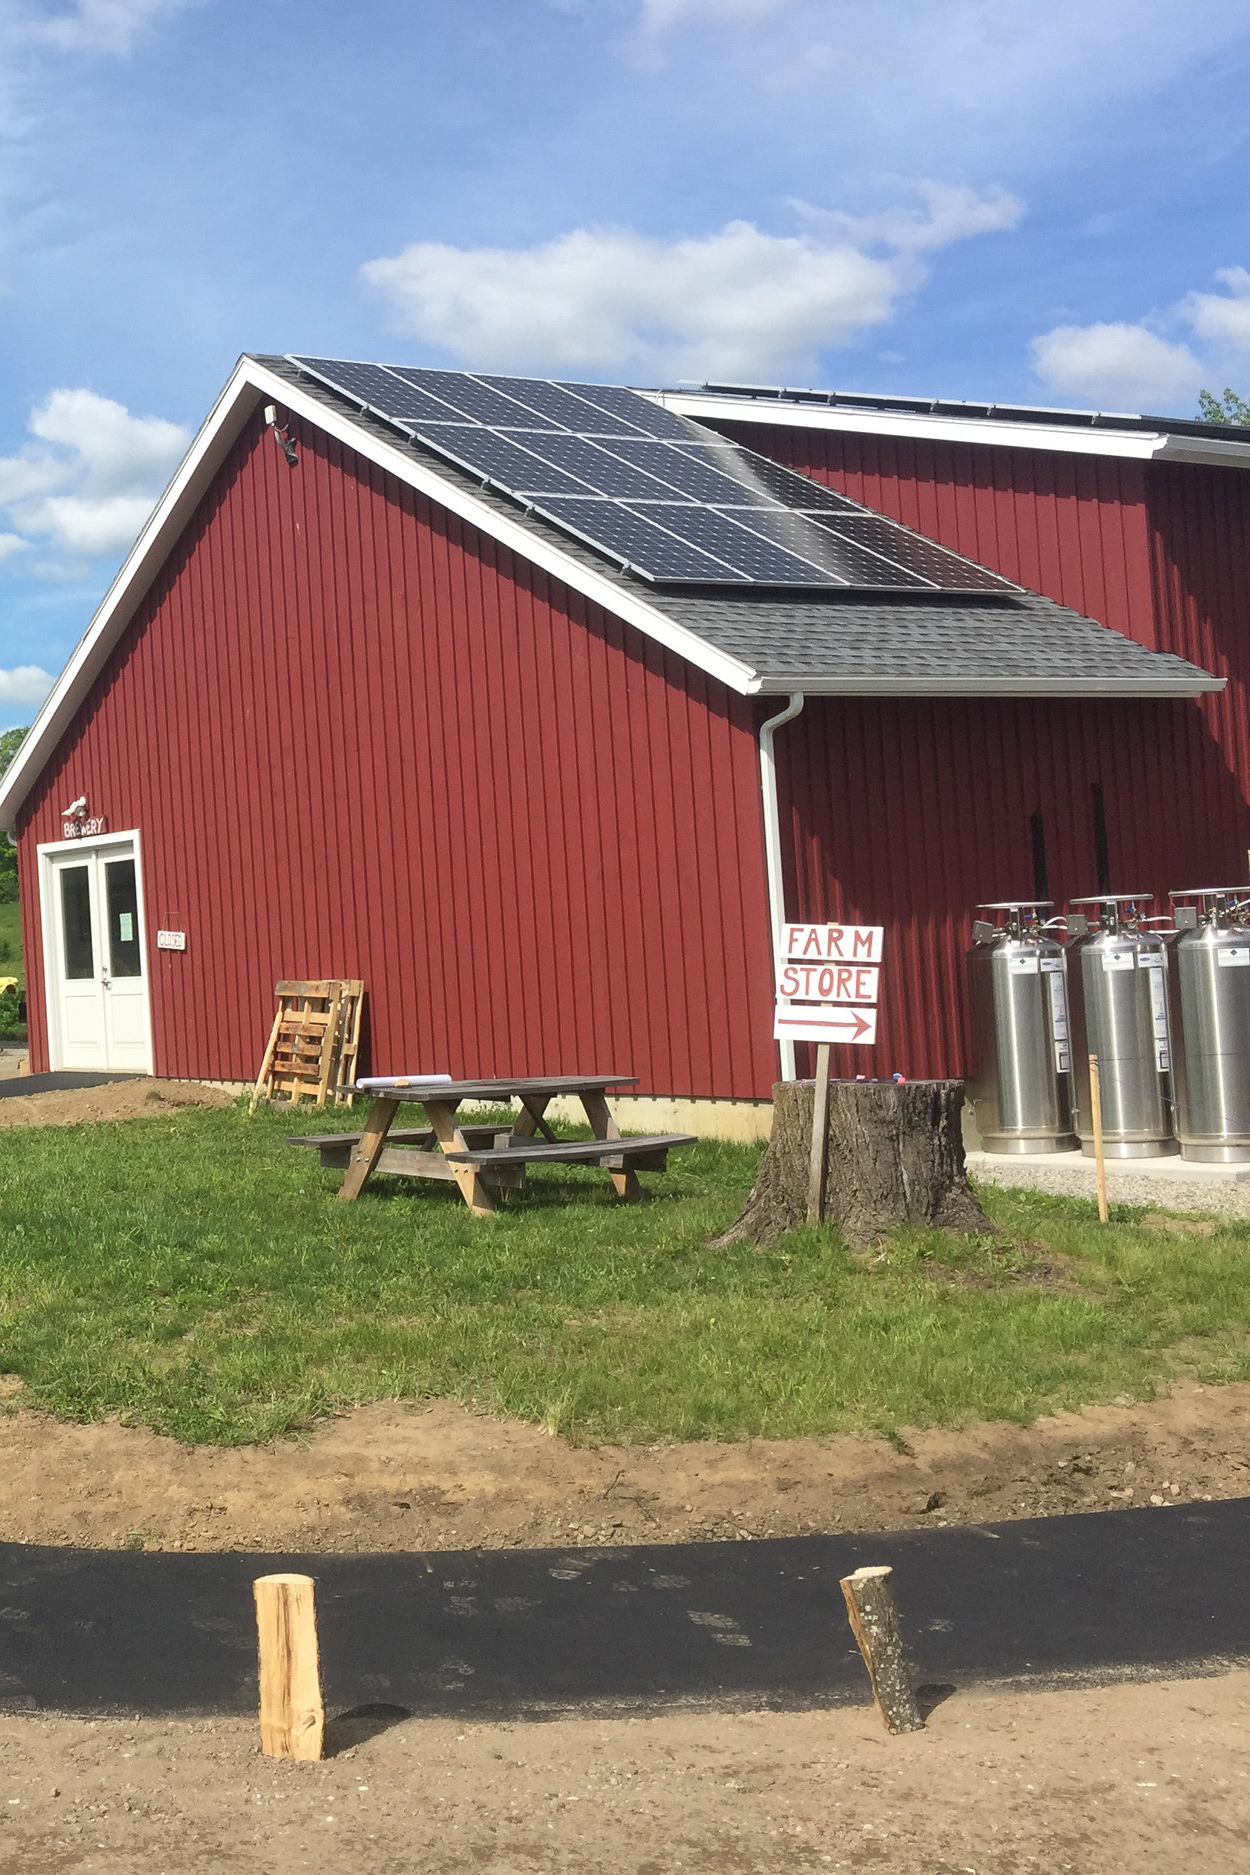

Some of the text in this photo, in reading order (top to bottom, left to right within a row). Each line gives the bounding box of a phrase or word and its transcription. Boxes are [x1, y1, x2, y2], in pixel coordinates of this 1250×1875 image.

[63, 817, 103, 838] BREWERY
[788, 927, 874, 957] FARM
[780, 967, 872, 999] STORE
